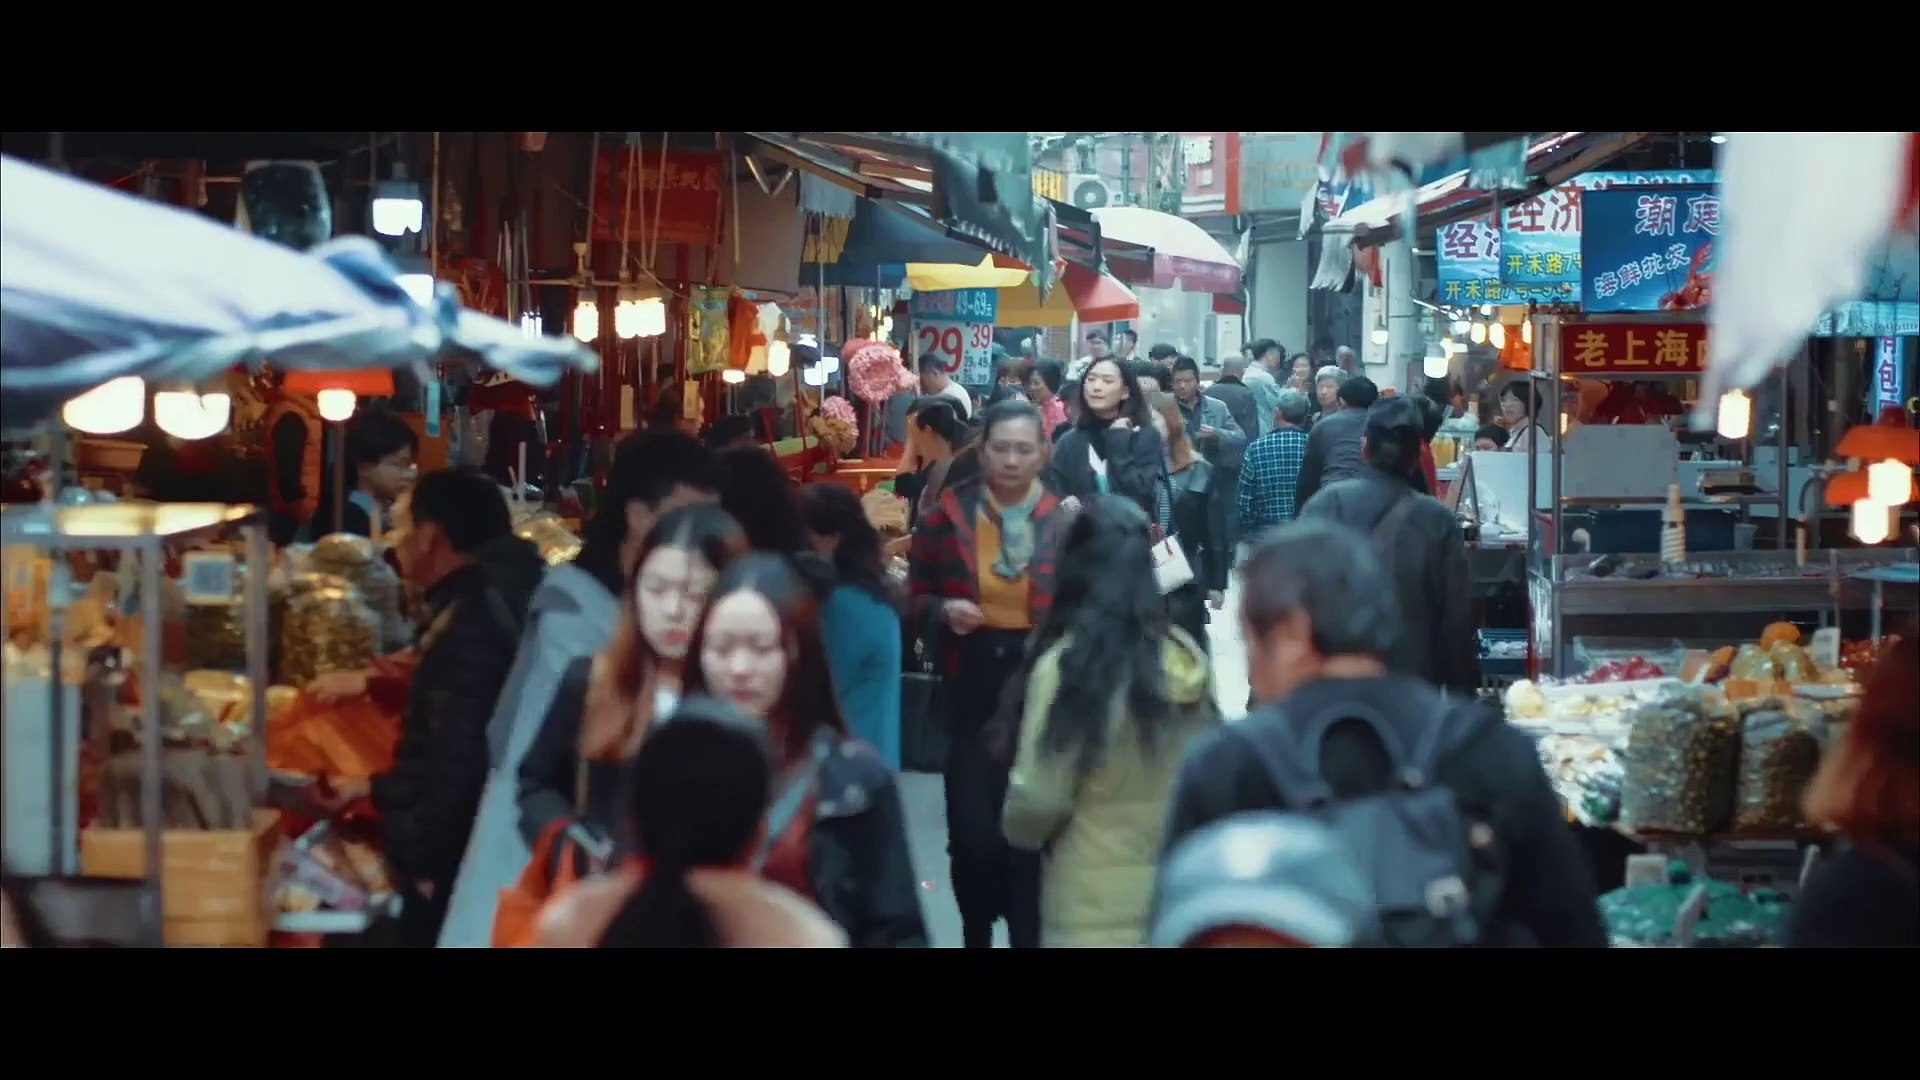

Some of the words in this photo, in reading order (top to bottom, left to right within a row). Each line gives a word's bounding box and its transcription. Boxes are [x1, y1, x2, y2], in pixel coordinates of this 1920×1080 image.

[1594, 243, 1691, 298] 海鲜批发
[918, 325, 963, 374] 29
[970, 323, 990, 349] 39
